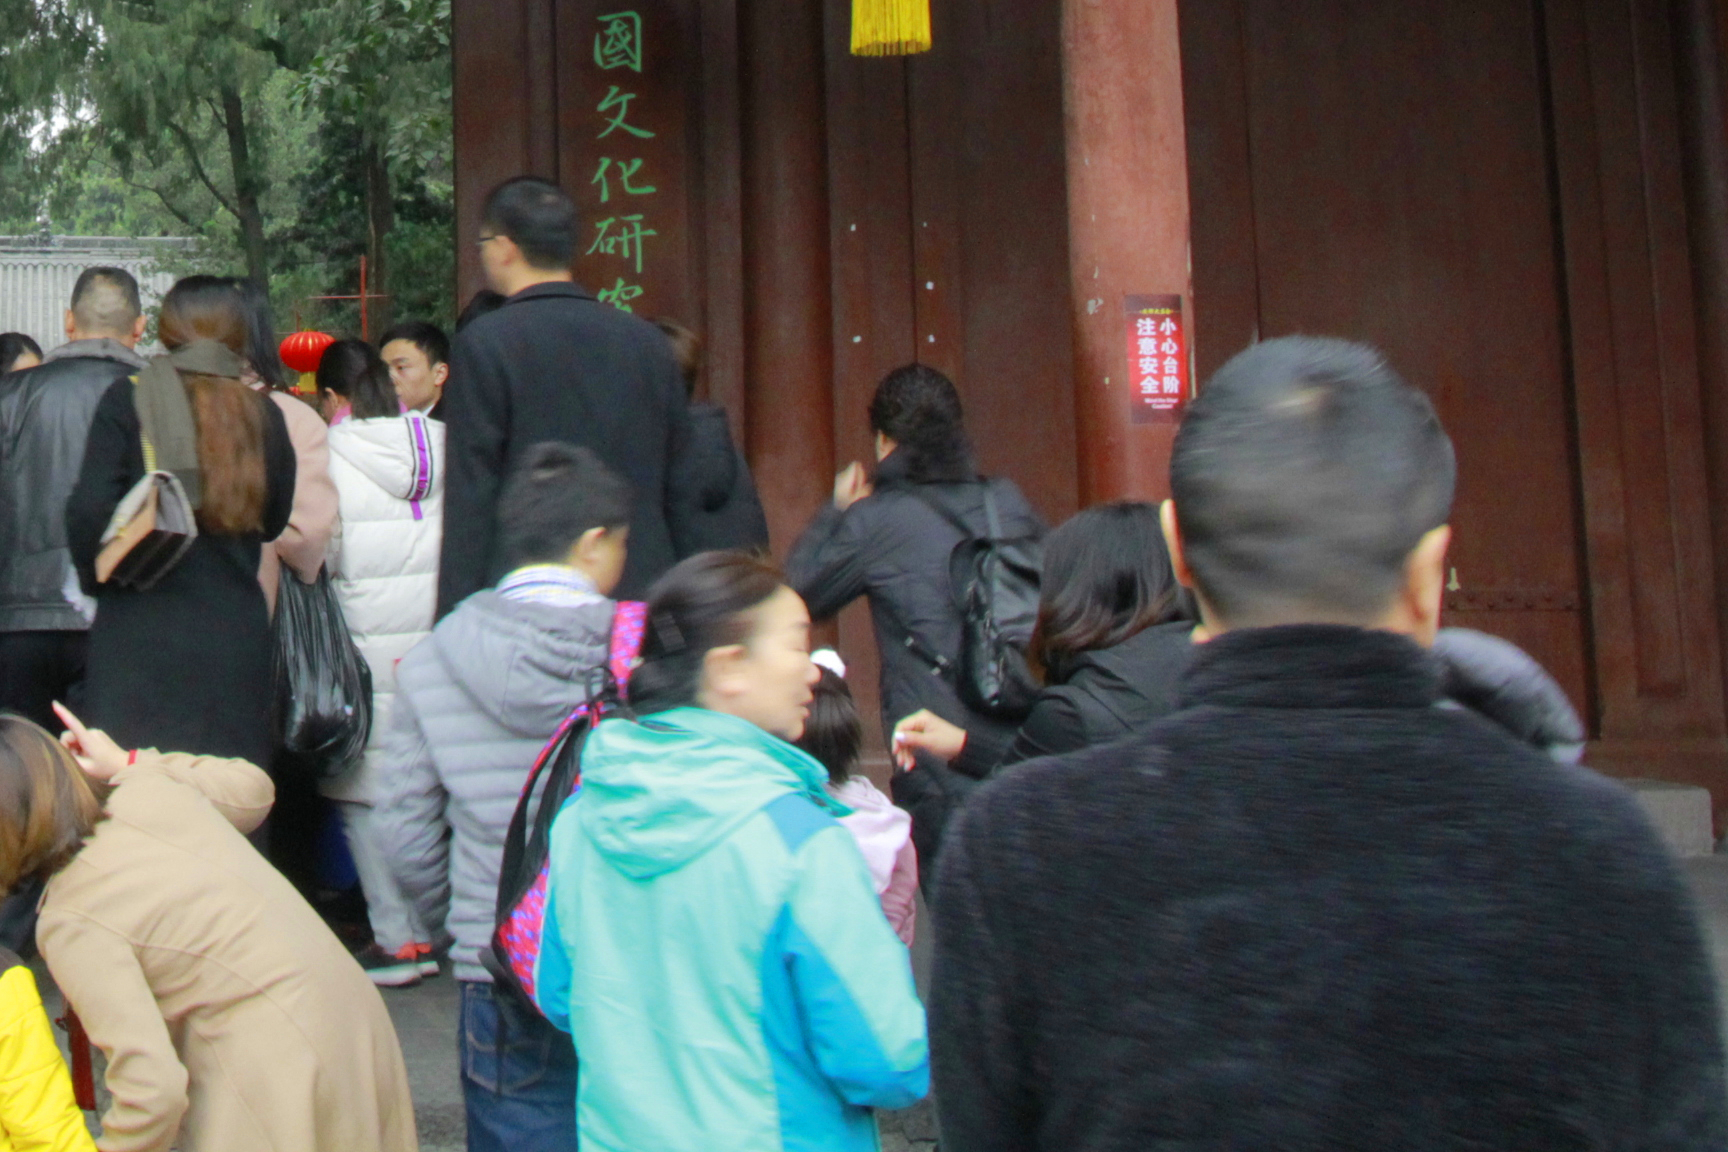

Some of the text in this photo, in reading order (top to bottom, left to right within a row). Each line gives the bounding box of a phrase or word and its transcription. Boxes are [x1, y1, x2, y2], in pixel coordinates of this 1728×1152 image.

[1136, 317, 1160, 394] 注意安全
[1159, 317, 1180, 394] 小心台阶
